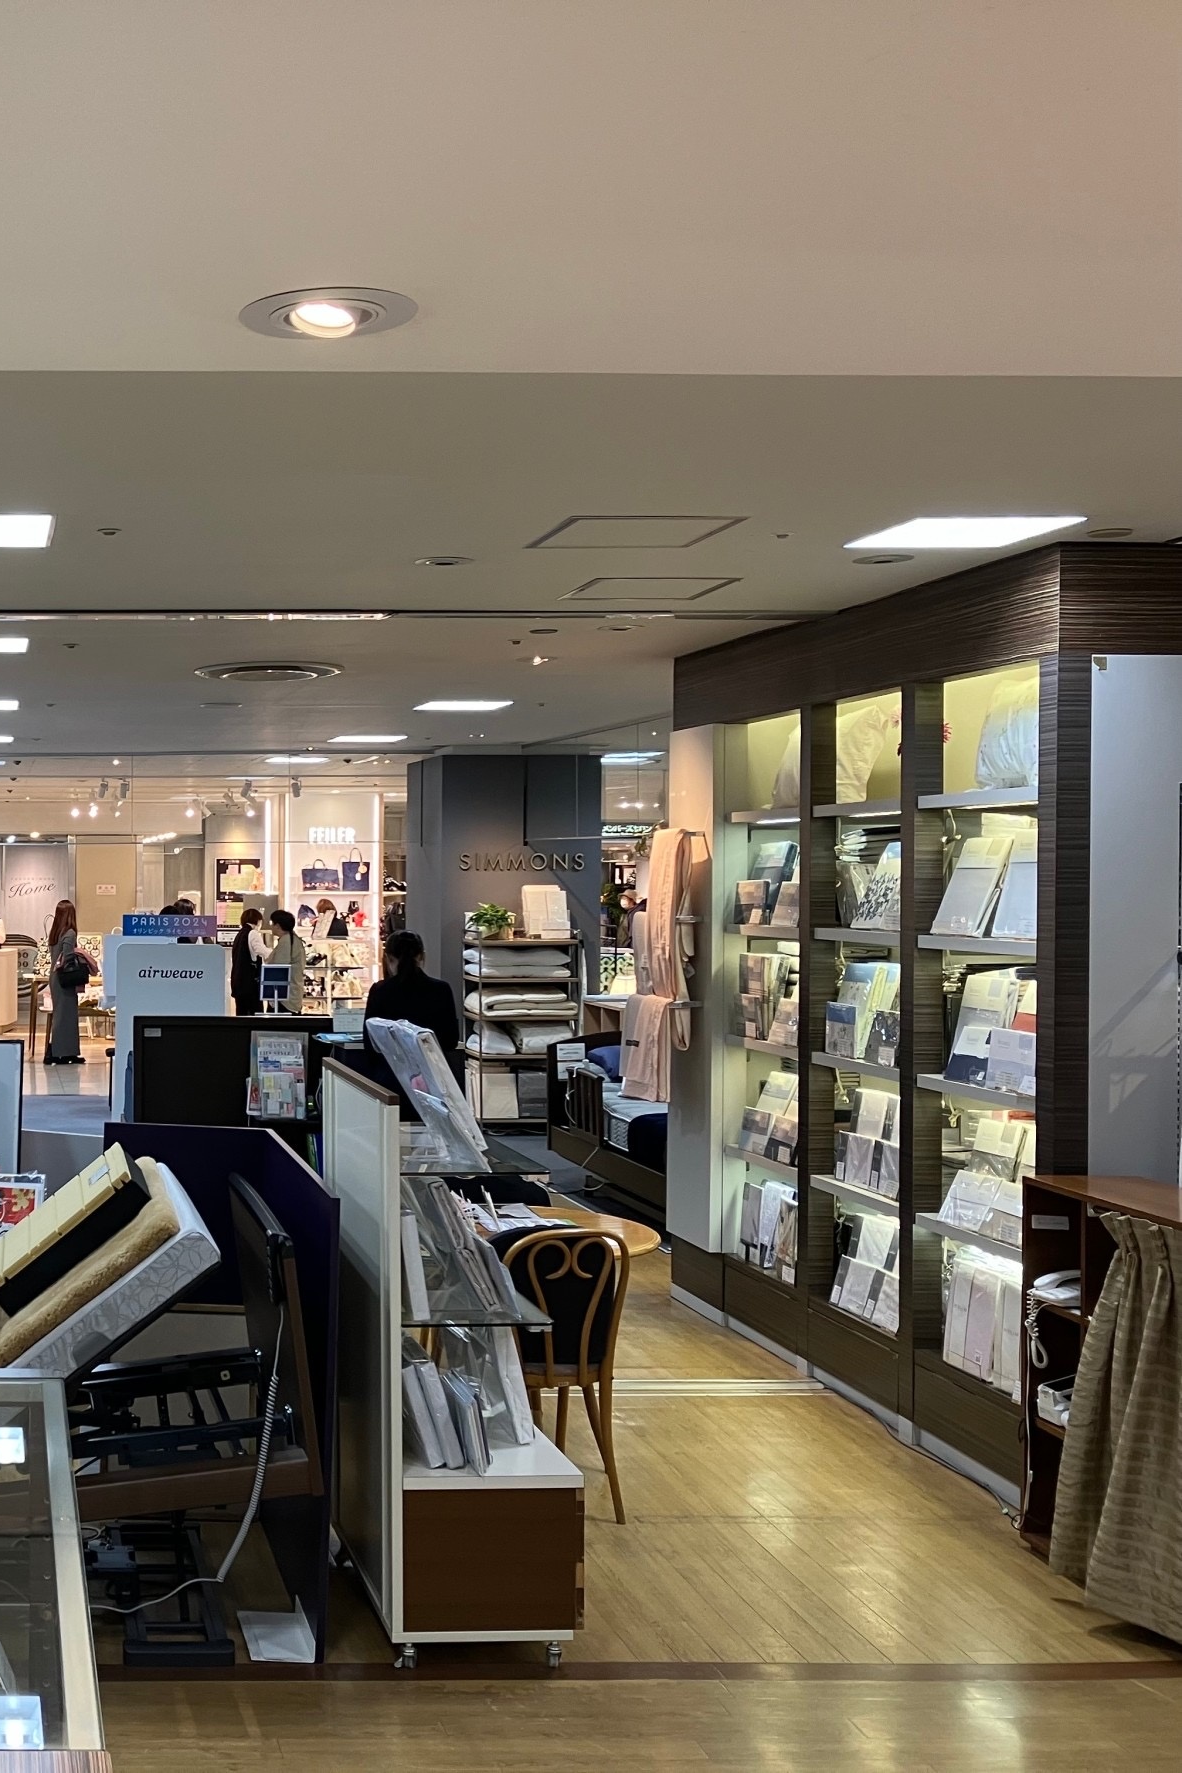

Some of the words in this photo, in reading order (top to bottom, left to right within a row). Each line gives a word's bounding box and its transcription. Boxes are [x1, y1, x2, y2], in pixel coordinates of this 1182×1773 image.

[308, 826, 356, 845] FEILER
[459, 852, 585, 872] SIMMONS
[8, 881, 57, 899] Home
[131, 916, 169, 927] PARIS
[173, 917, 208, 927] 2024
[138, 965, 204, 980] airweave
